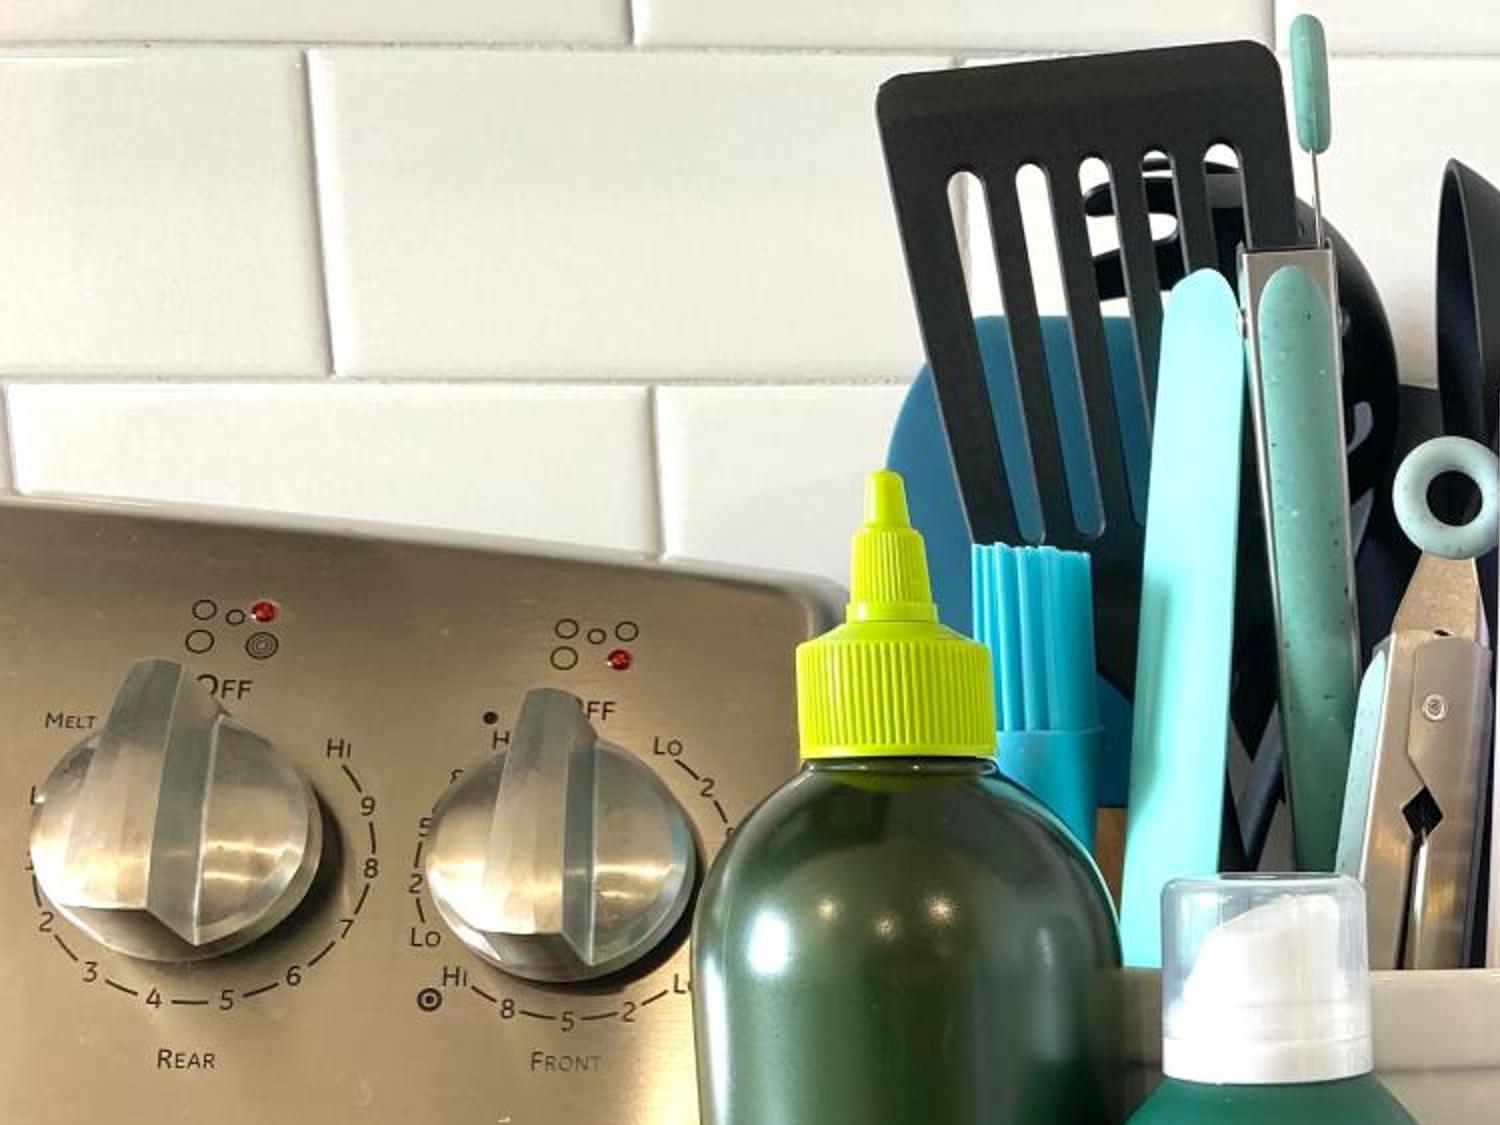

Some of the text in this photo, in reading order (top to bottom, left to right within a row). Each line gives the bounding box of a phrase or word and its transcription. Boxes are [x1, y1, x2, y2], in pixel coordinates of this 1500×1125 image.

[577, 697, 617, 721] FF
[700, 777, 715, 797] 2
[361, 796, 376, 816] 9
[363, 858, 378, 879] 8
[408, 874, 423, 894] 2
[38, 911, 55, 932] 2
[339, 919, 354, 940] 7
[82, 961, 98, 983] 3
[286, 964, 301, 986] 6
[145, 988, 162, 1010] 4
[218, 989, 234, 1011] 5
[500, 999, 515, 1019] 8
[560, 1011, 575, 1032] 5
[620, 1001, 637, 1023] 2
